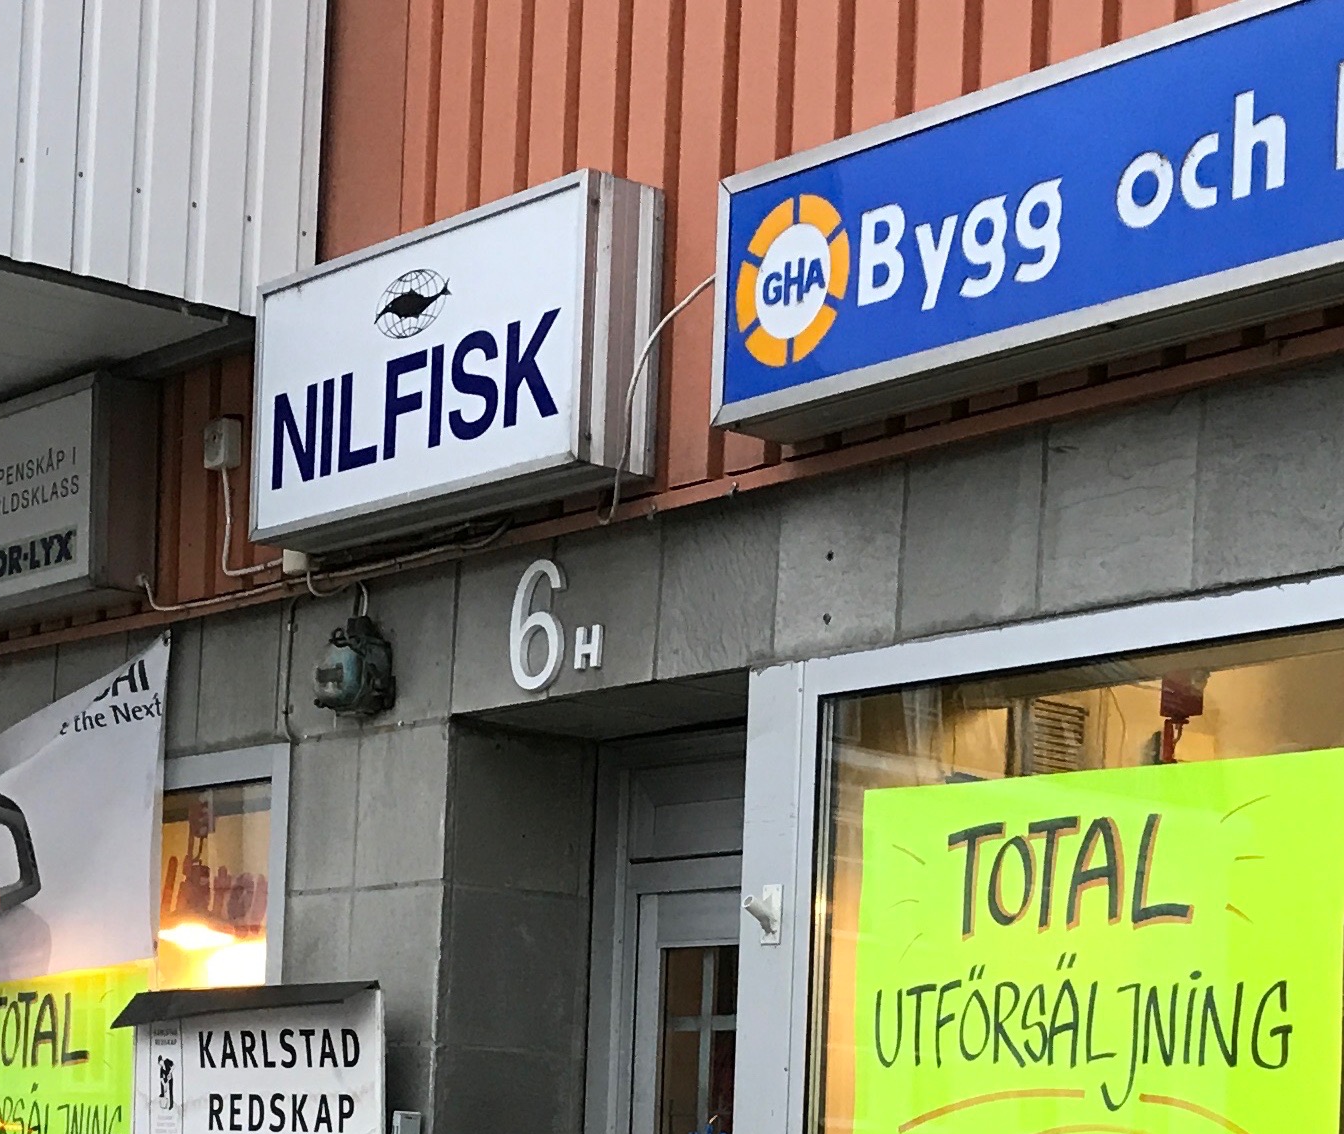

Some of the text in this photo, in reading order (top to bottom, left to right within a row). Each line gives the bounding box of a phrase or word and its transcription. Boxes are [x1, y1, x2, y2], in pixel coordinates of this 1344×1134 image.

[857, 177, 1064, 310] Bygg
[1116, 89, 1287, 229] och
[762, 256, 827, 307] GHA
[271, 307, 562, 490] NILFISK
[508, 558, 603, 693] 6 H
[74, 710, 107, 733] the
[109, 692, 163, 725] Next
[947, 812, 1194, 942] TOTAL
[198, 1028, 361, 1069] KARLSTAD
[874, 952, 1294, 1112] UTFÖRSÄLJNING
[208, 1092, 355, 1133] REDSKAP
